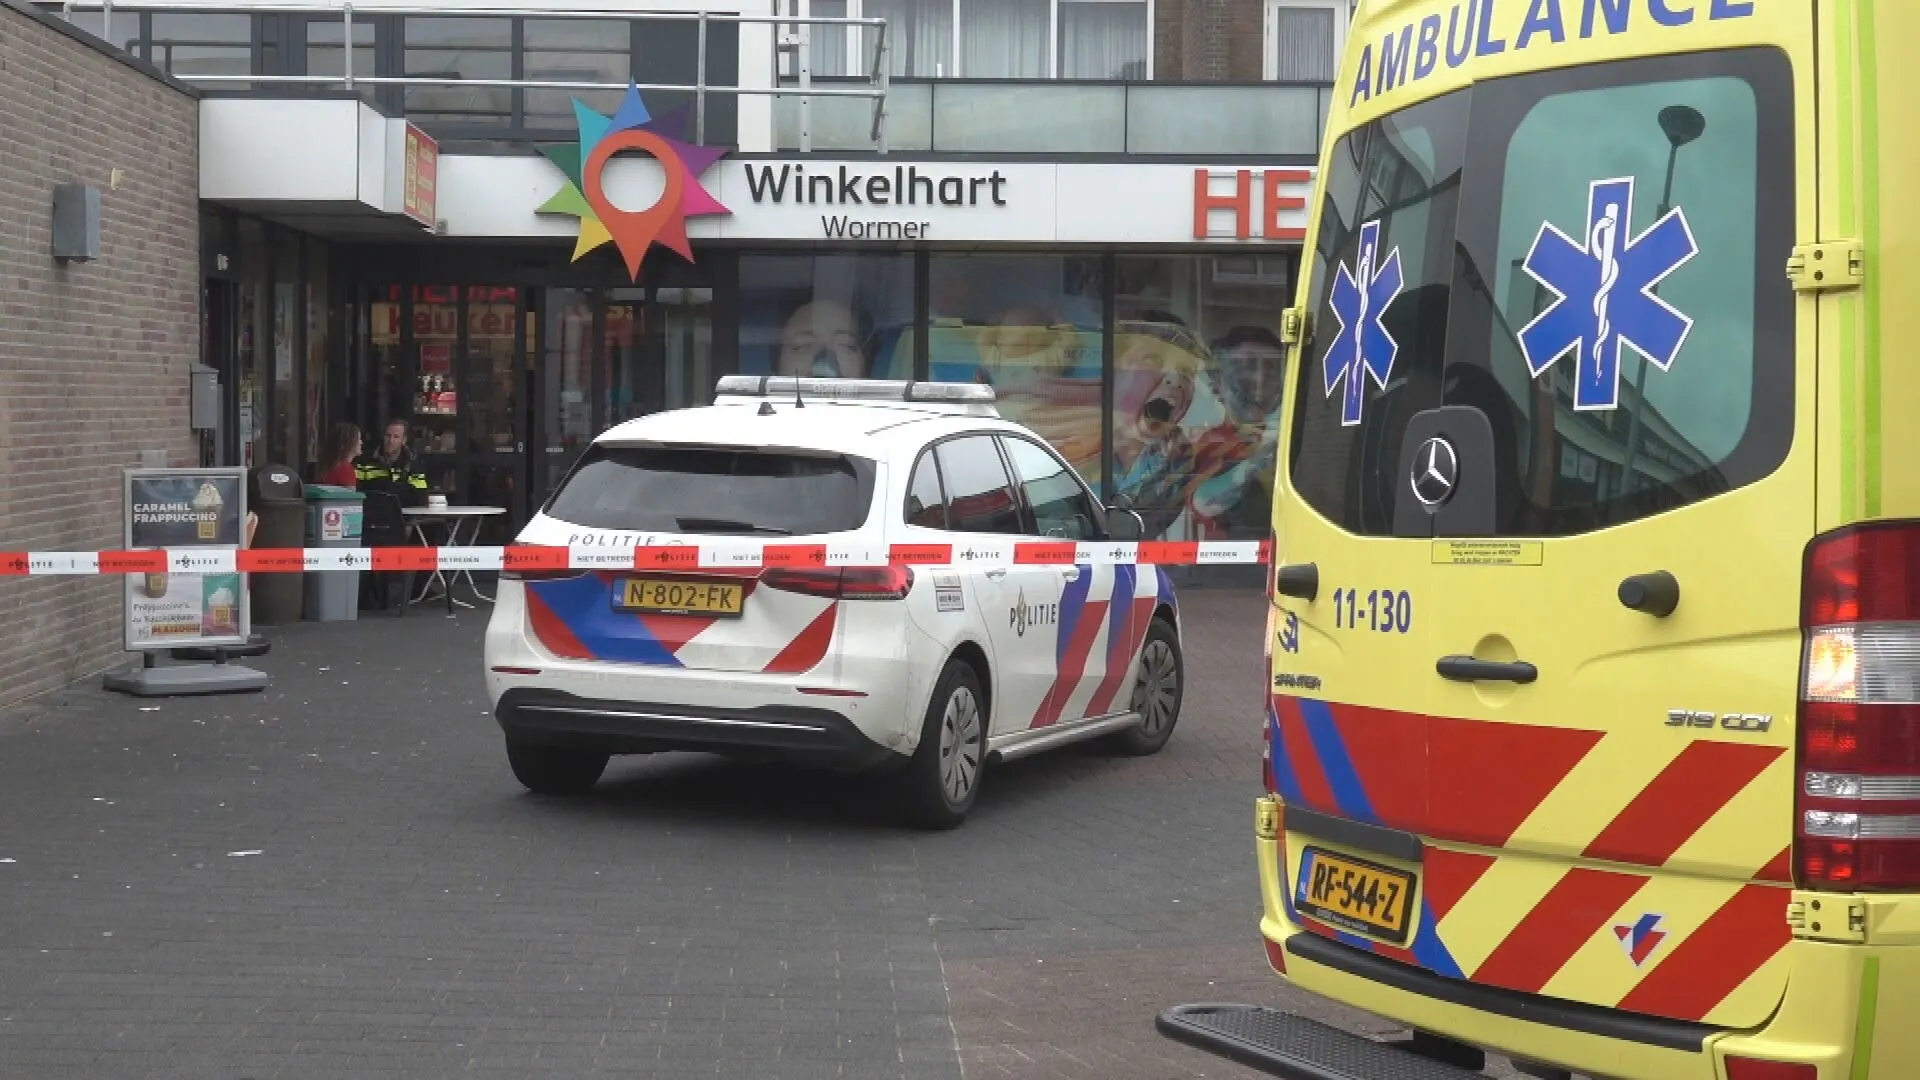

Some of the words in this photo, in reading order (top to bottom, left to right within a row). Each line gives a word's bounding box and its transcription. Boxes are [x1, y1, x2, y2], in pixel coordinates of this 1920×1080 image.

[1349, 0, 1755, 109] AMBULAN
[744, 163, 1006, 205] Winkelhart
[821, 215, 930, 239] Wormer
[133, 503, 191, 513] CARAMEL
[133, 513, 217, 523] FRAPPUCCINO
[960, 549, 1001, 560] POLITIE
[630, 583, 733, 608] N-802-FK
[1009, 602, 1057, 637] POLITIE
[1333, 588, 1411, 634] 11-130
[1664, 709, 1716, 729] 319
[1720, 713, 1773, 732] CDI
[1311, 861, 1400, 923] RF-544-Z
